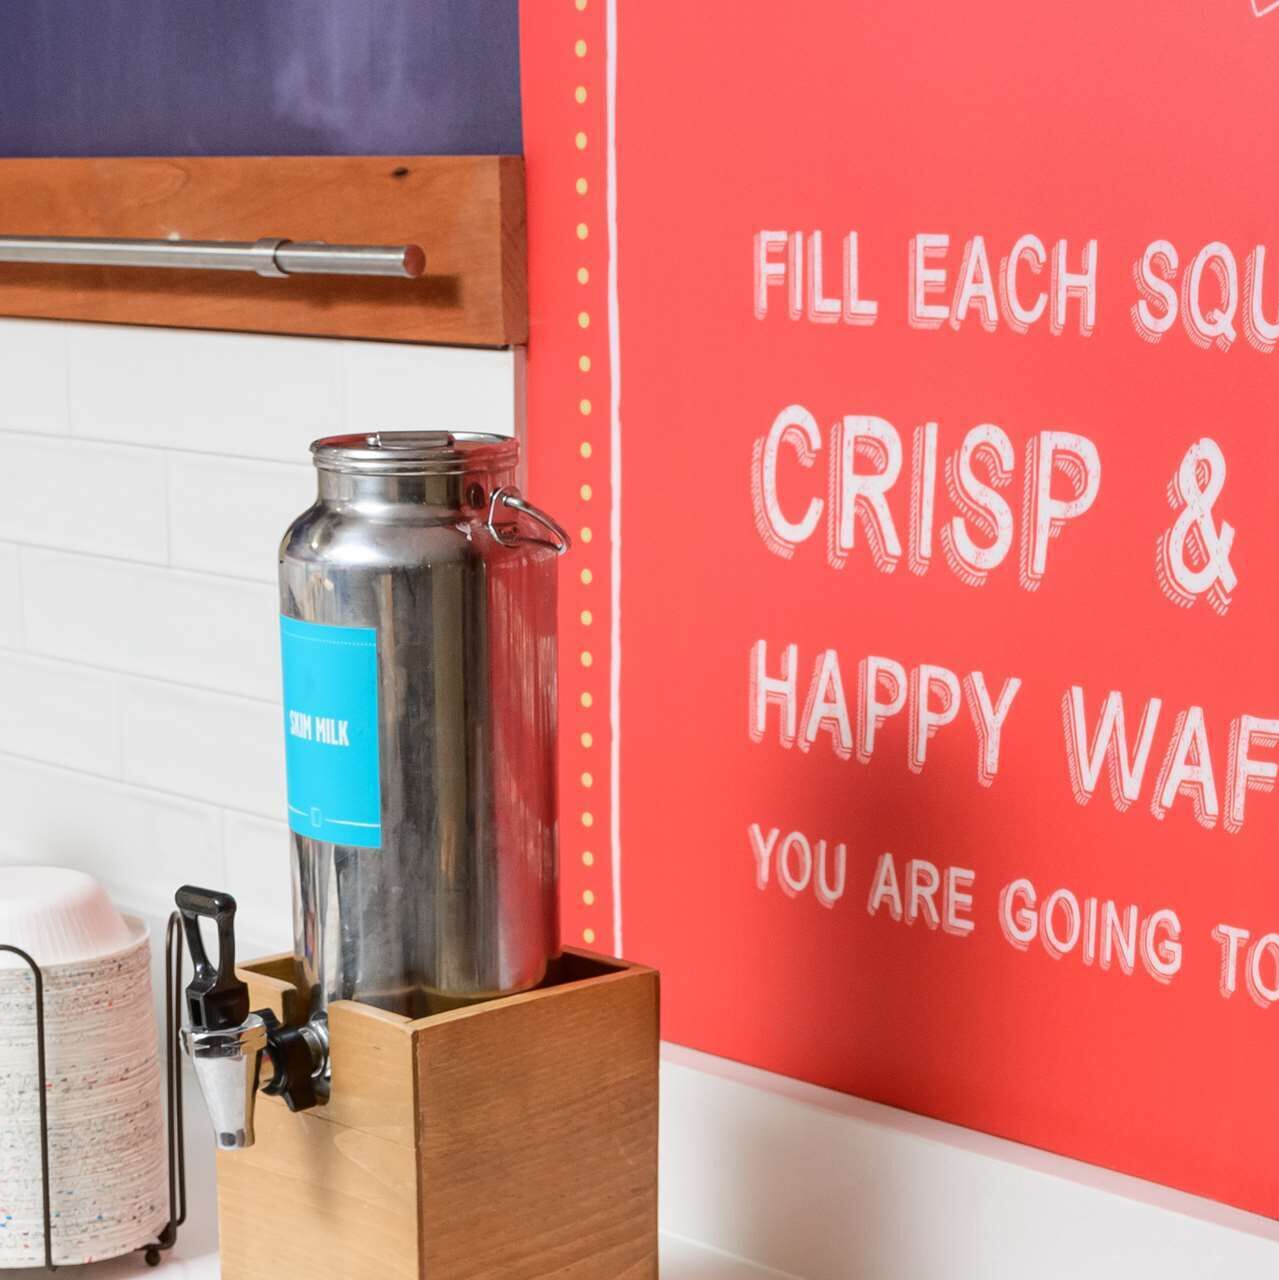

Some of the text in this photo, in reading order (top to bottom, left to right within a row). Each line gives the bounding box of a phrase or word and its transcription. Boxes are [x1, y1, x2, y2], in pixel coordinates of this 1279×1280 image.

[753, 229, 878, 326] FILL
[907, 233, 1099, 336] EACH
[750, 403, 1101, 591] CRISP
[1155, 436, 1238, 616] &
[289, 710, 350, 747] SKIM MILK
[748, 639, 1021, 789] HAPPY
[748, 823, 847, 910] YOU
[867, 852, 976, 936] ARE
[998, 878, 1182, 986] GOING
